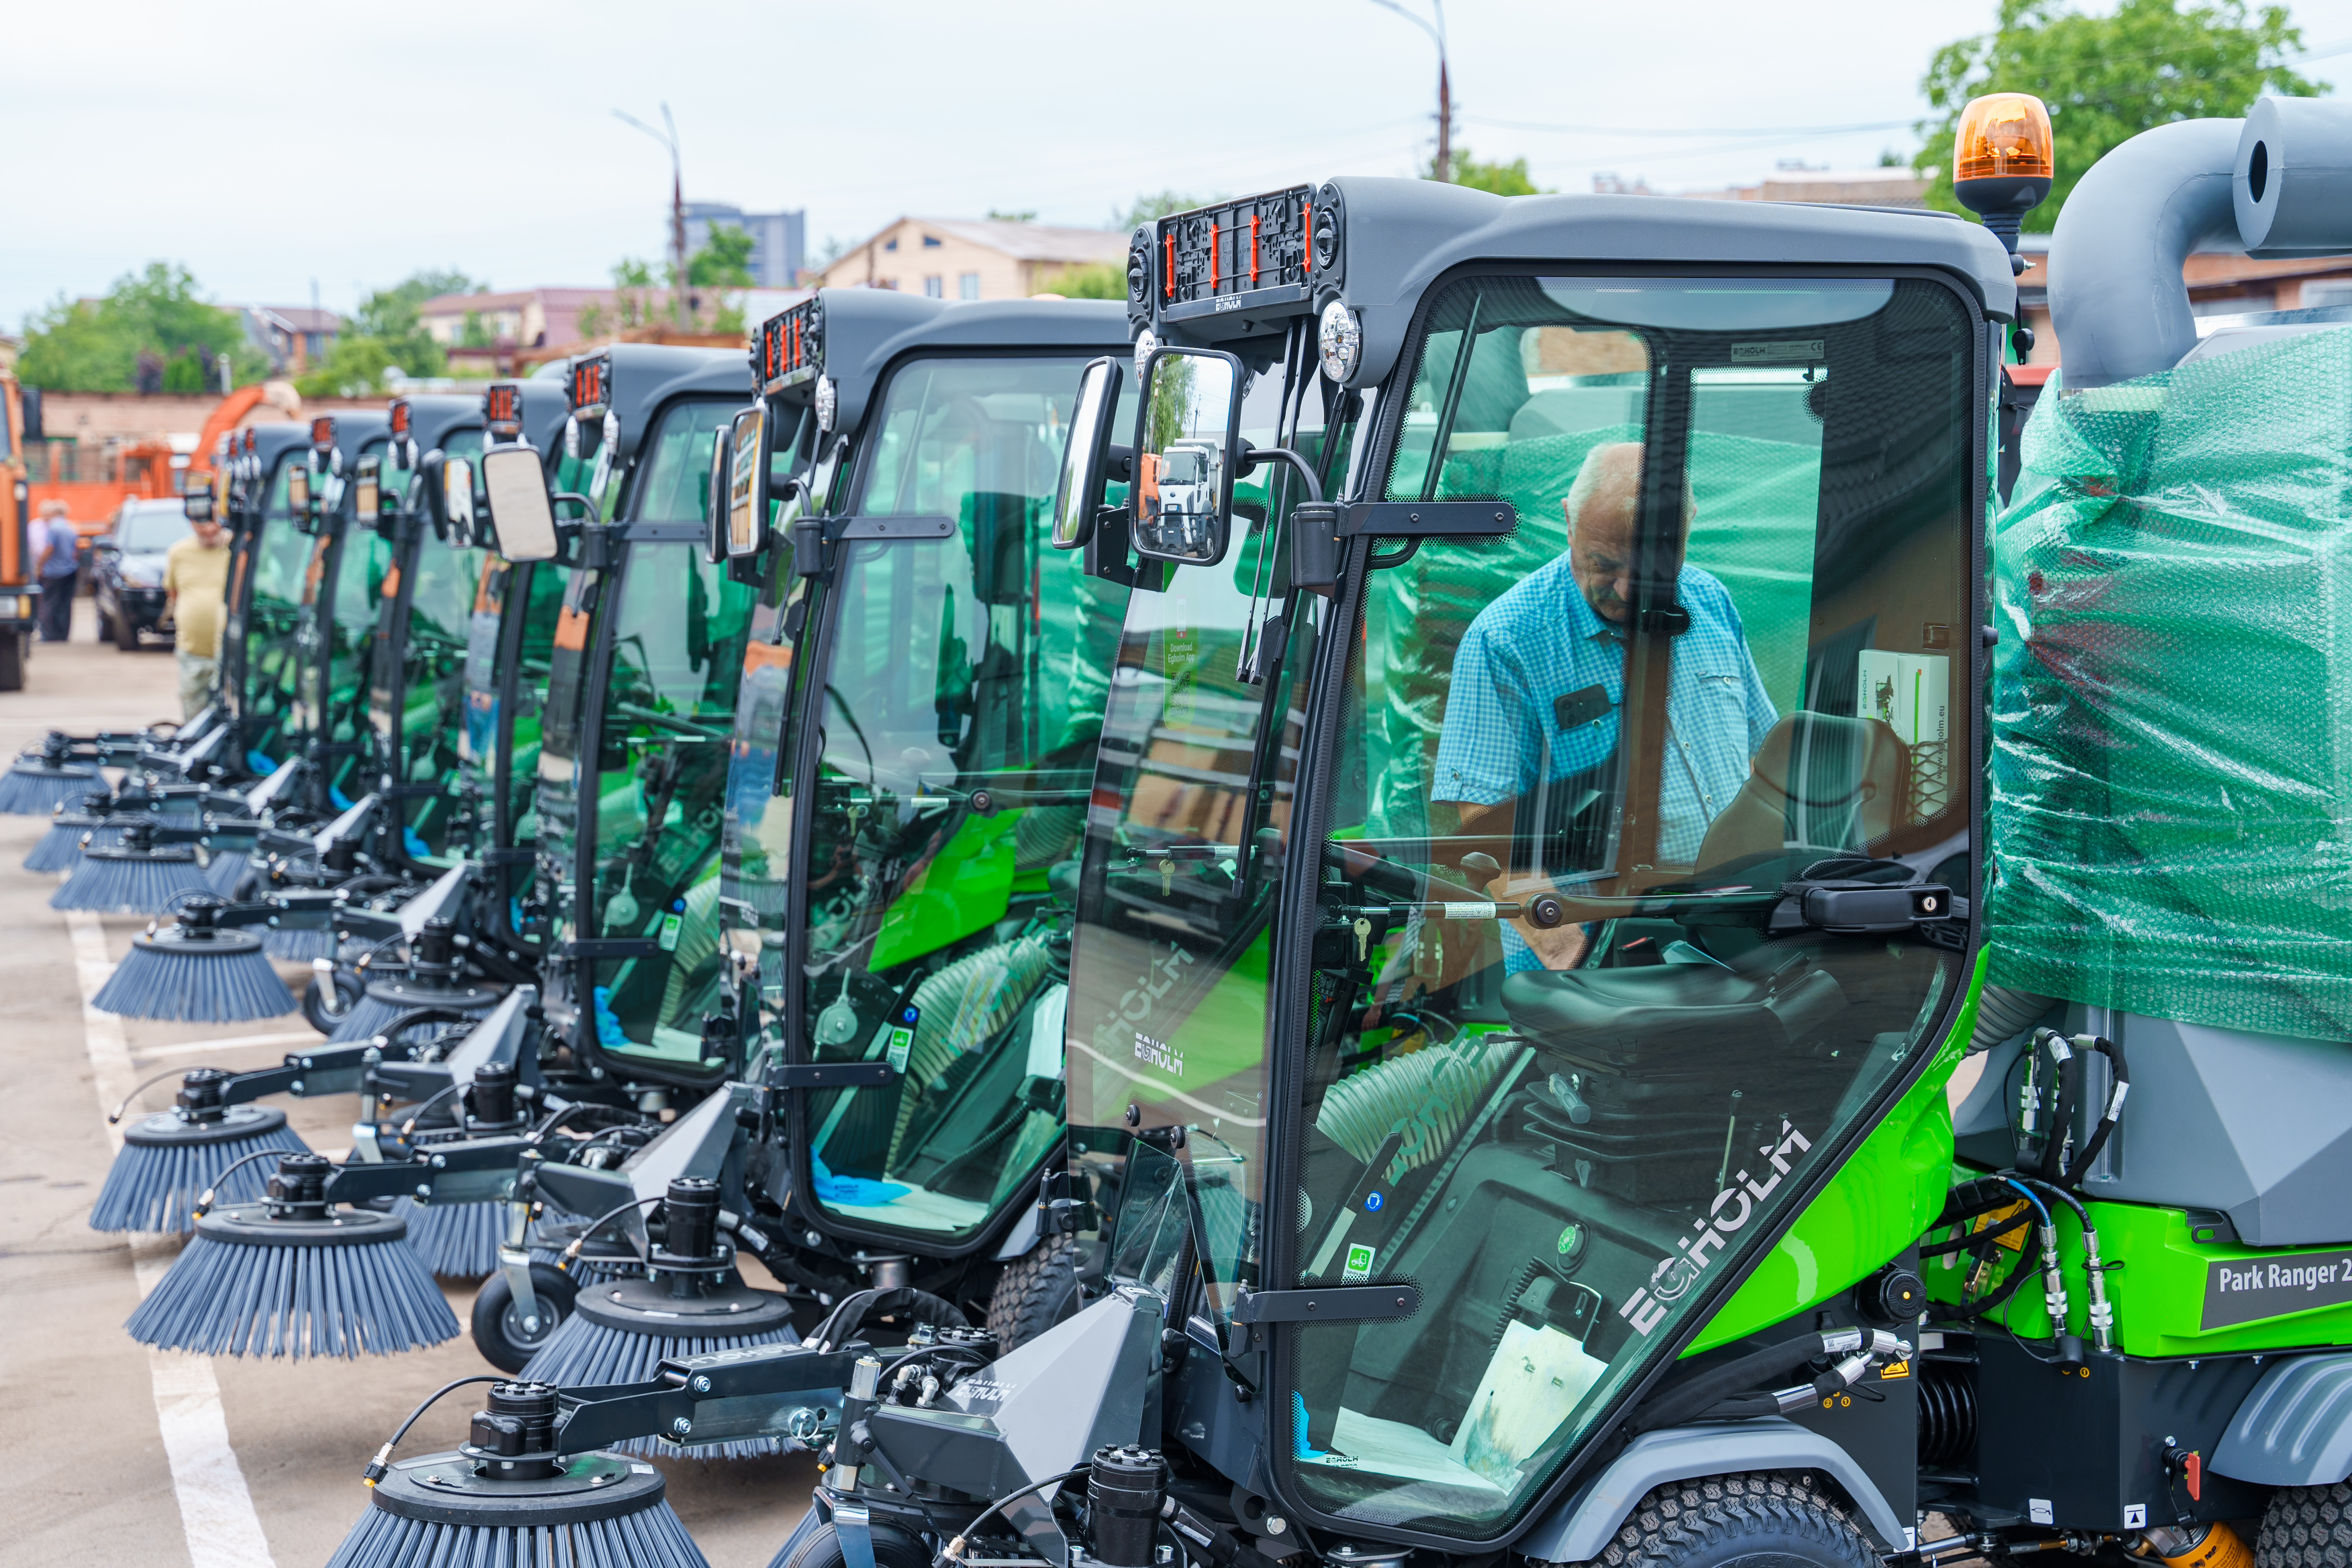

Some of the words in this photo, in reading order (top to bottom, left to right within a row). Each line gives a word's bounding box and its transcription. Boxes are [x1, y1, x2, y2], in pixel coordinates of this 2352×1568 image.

[1215, 294, 1241, 312] EGHOLM
[1170, 642, 1193, 652] Download
[1168, 653, 1185, 665] Egholm
[1186, 652, 1195, 664] App
[1134, 1032, 1184, 1076] EGHOLM
[1619, 1119, 1812, 1337] EGHOLM
[1894, 1275, 1912, 1285] DIESEL
[2220, 1265, 2264, 1292] Park
[2268, 1263, 2338, 1291] Ranger
[1902, 1306, 1920, 1316] DIESEL
[954, 1378, 1017, 1402] EGHOLM
[2204, 1546, 2217, 1560] MP
